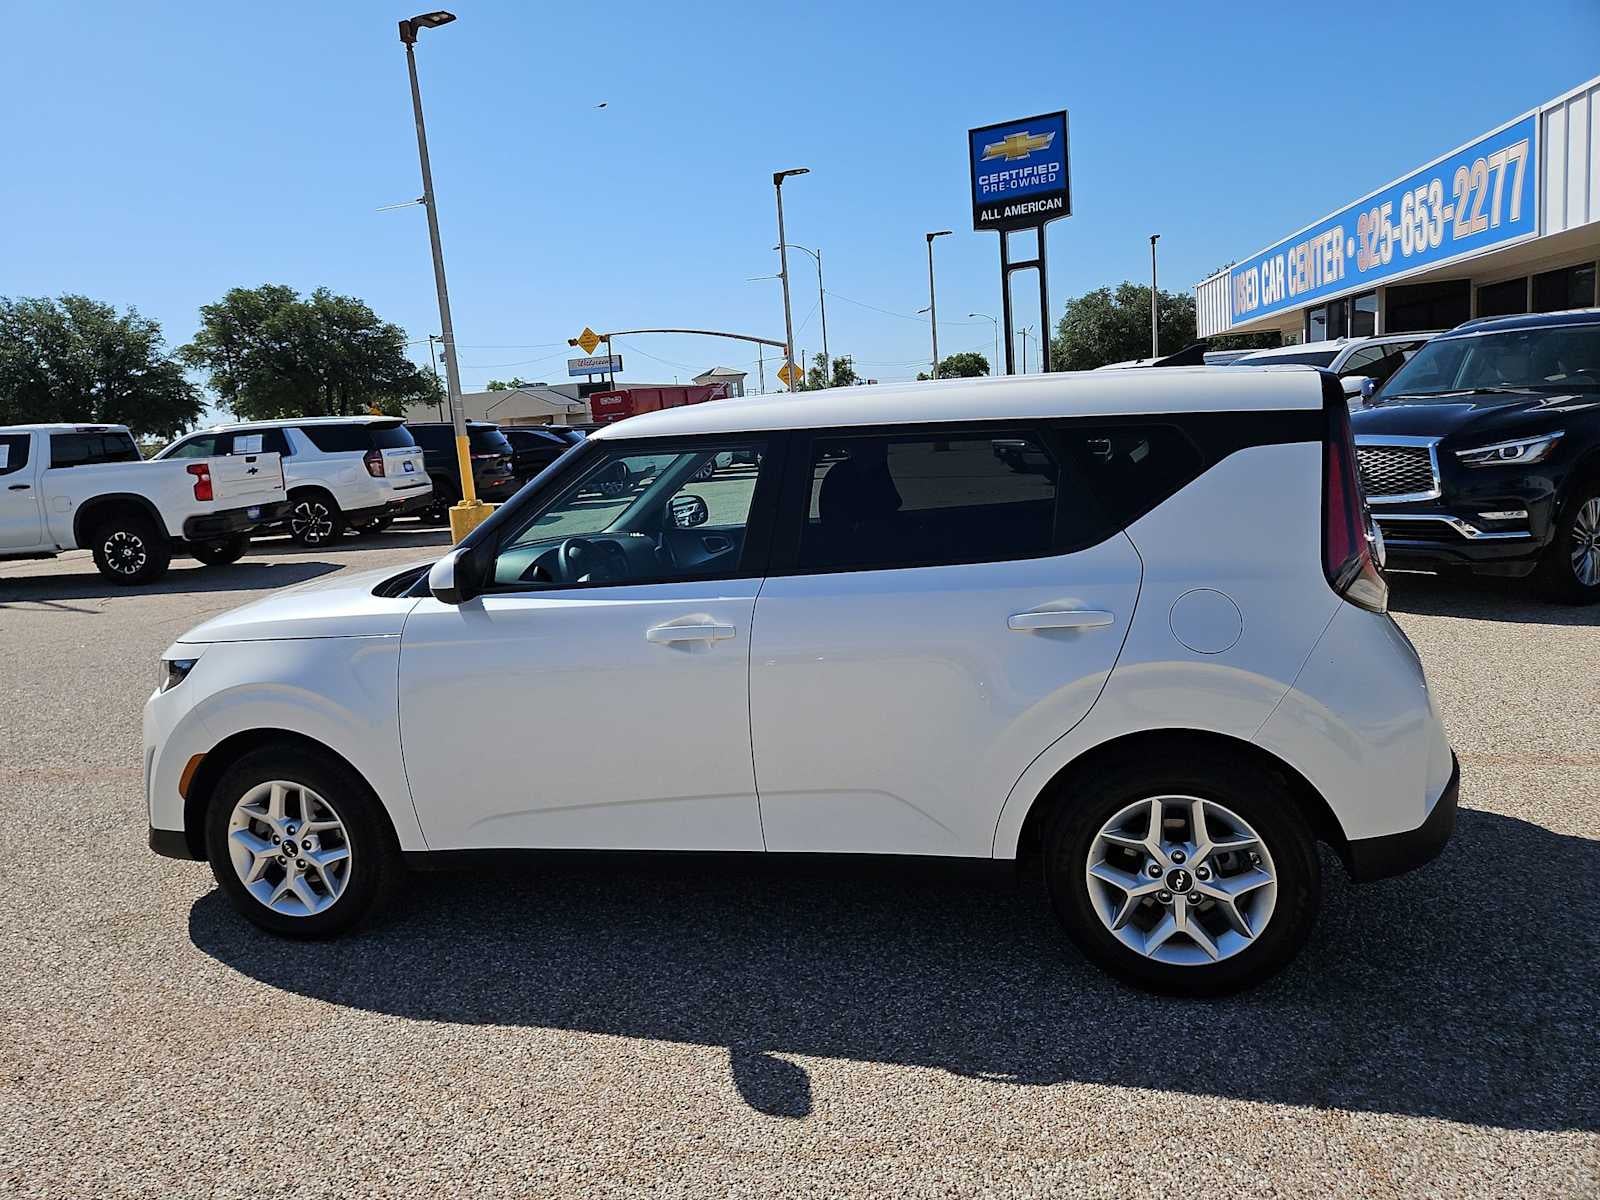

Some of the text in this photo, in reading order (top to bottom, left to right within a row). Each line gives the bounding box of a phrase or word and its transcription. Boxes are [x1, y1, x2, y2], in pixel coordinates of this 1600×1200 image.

[979, 162, 1060, 185] CERTIFIED
[983, 173, 1056, 194] PRE-OWNED
[981, 198, 1062, 221] ALL AMERICAN
[1233, 138, 1529, 316] USED CAR CENTER 325-653-2277
